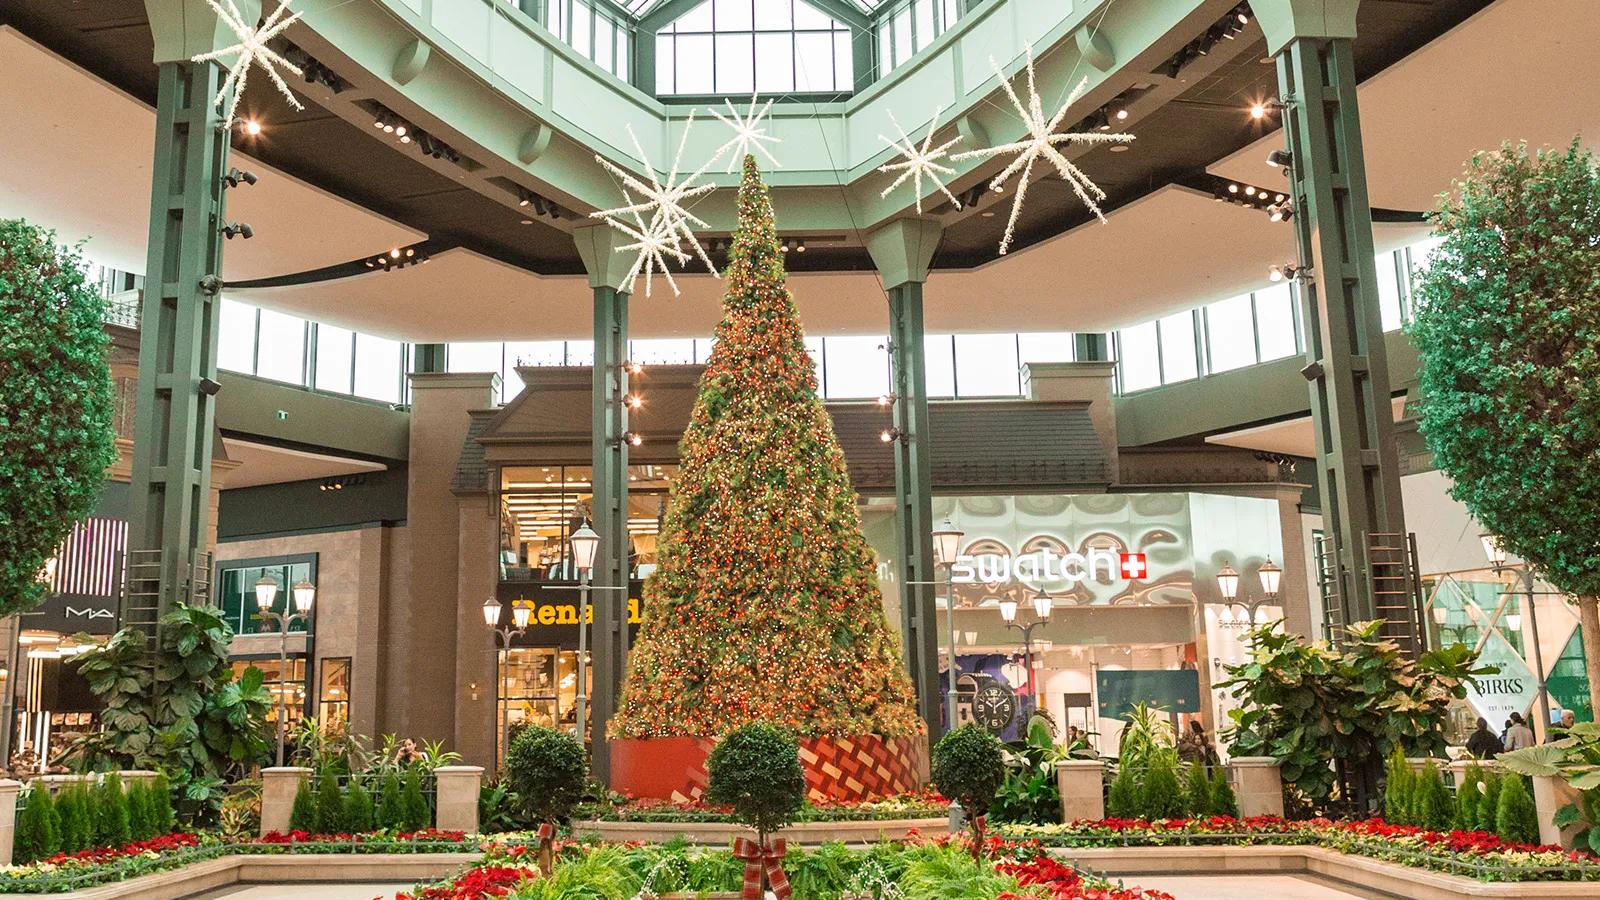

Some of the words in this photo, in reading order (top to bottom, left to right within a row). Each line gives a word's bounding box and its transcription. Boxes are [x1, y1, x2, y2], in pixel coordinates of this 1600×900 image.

[950, 546, 1117, 583] swatch
[511, 598, 642, 625] Renad
[1477, 678, 1523, 694] BIRKS
